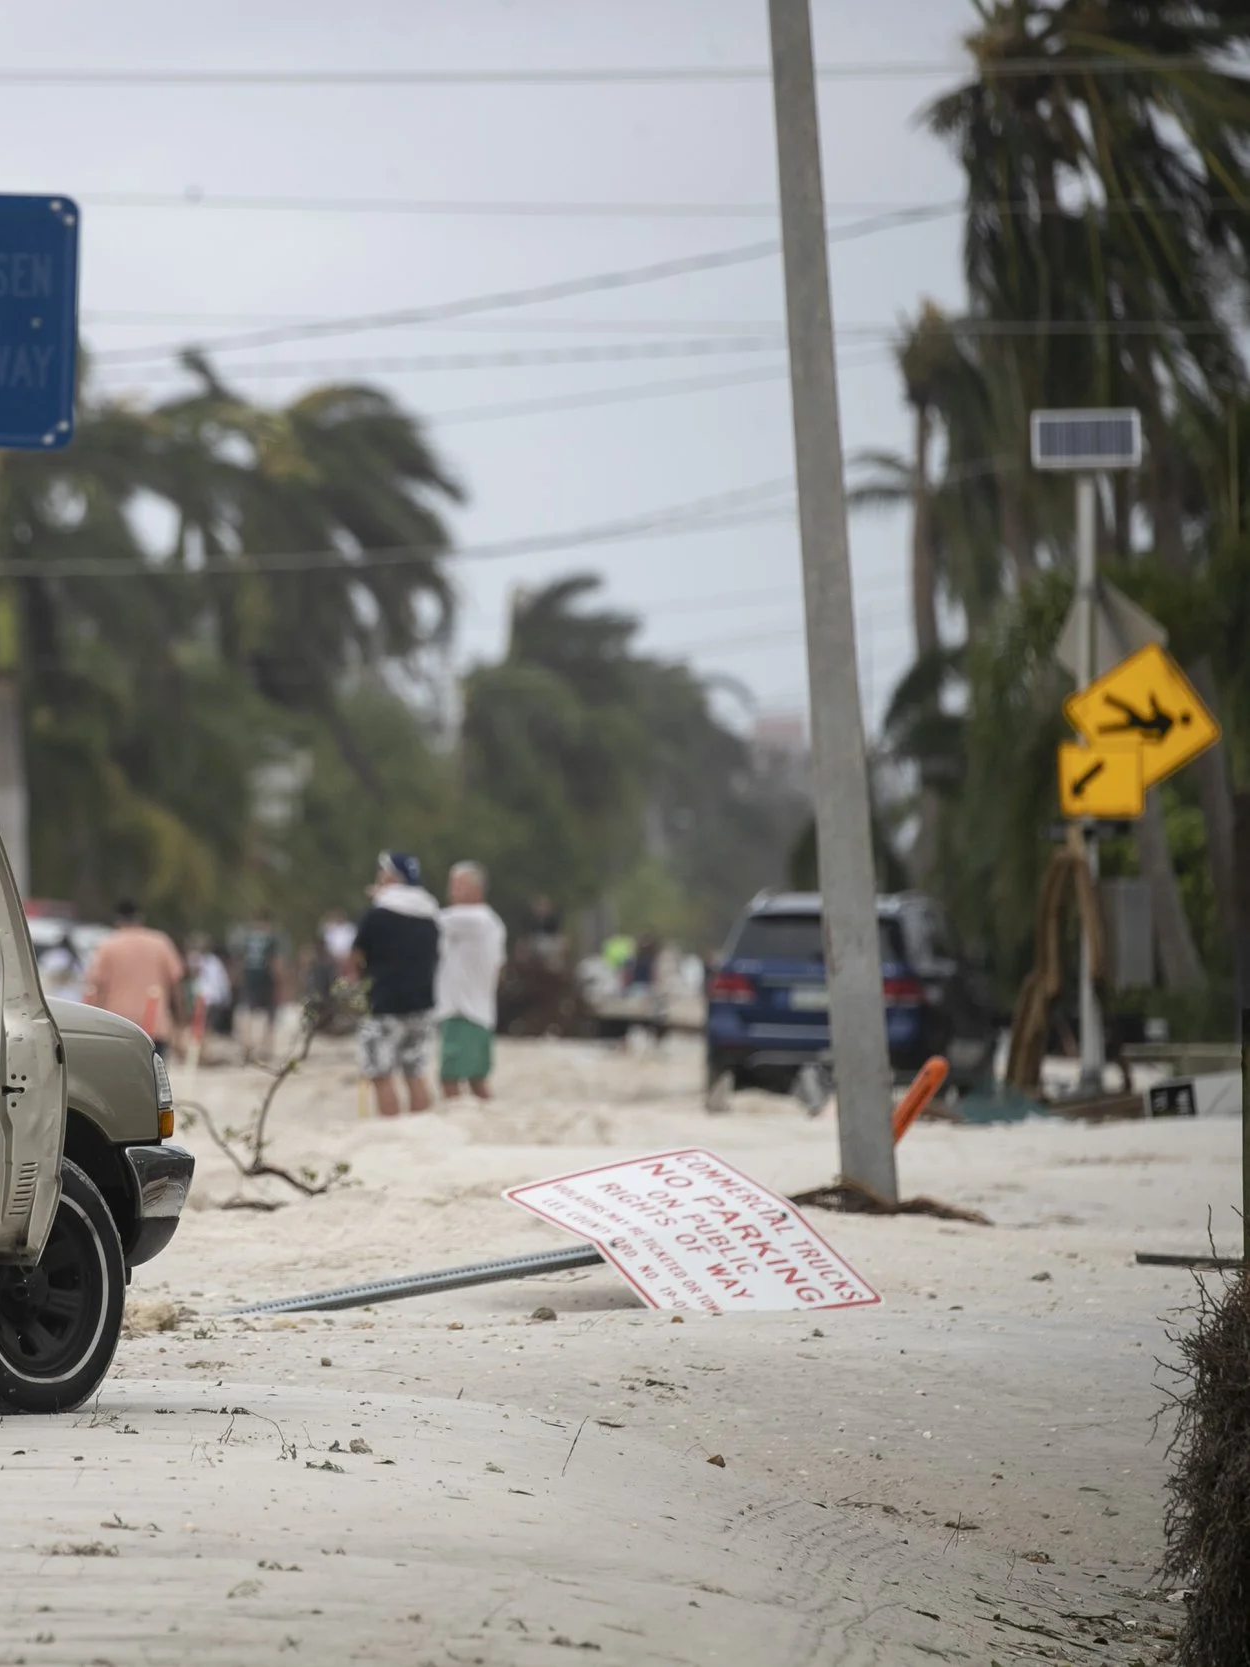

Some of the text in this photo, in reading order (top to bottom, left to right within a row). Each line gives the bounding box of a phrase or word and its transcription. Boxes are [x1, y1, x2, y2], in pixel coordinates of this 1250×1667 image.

[597, 1182, 755, 1299] RIGHTS OF WAY
[640, 1163, 825, 1303] NO PARKING
[647, 1190, 759, 1275] ON PUBLIC
[676, 1154, 863, 1301] COMMERCIAL TRUCKS
[682, 1279, 702, 1294] OR
